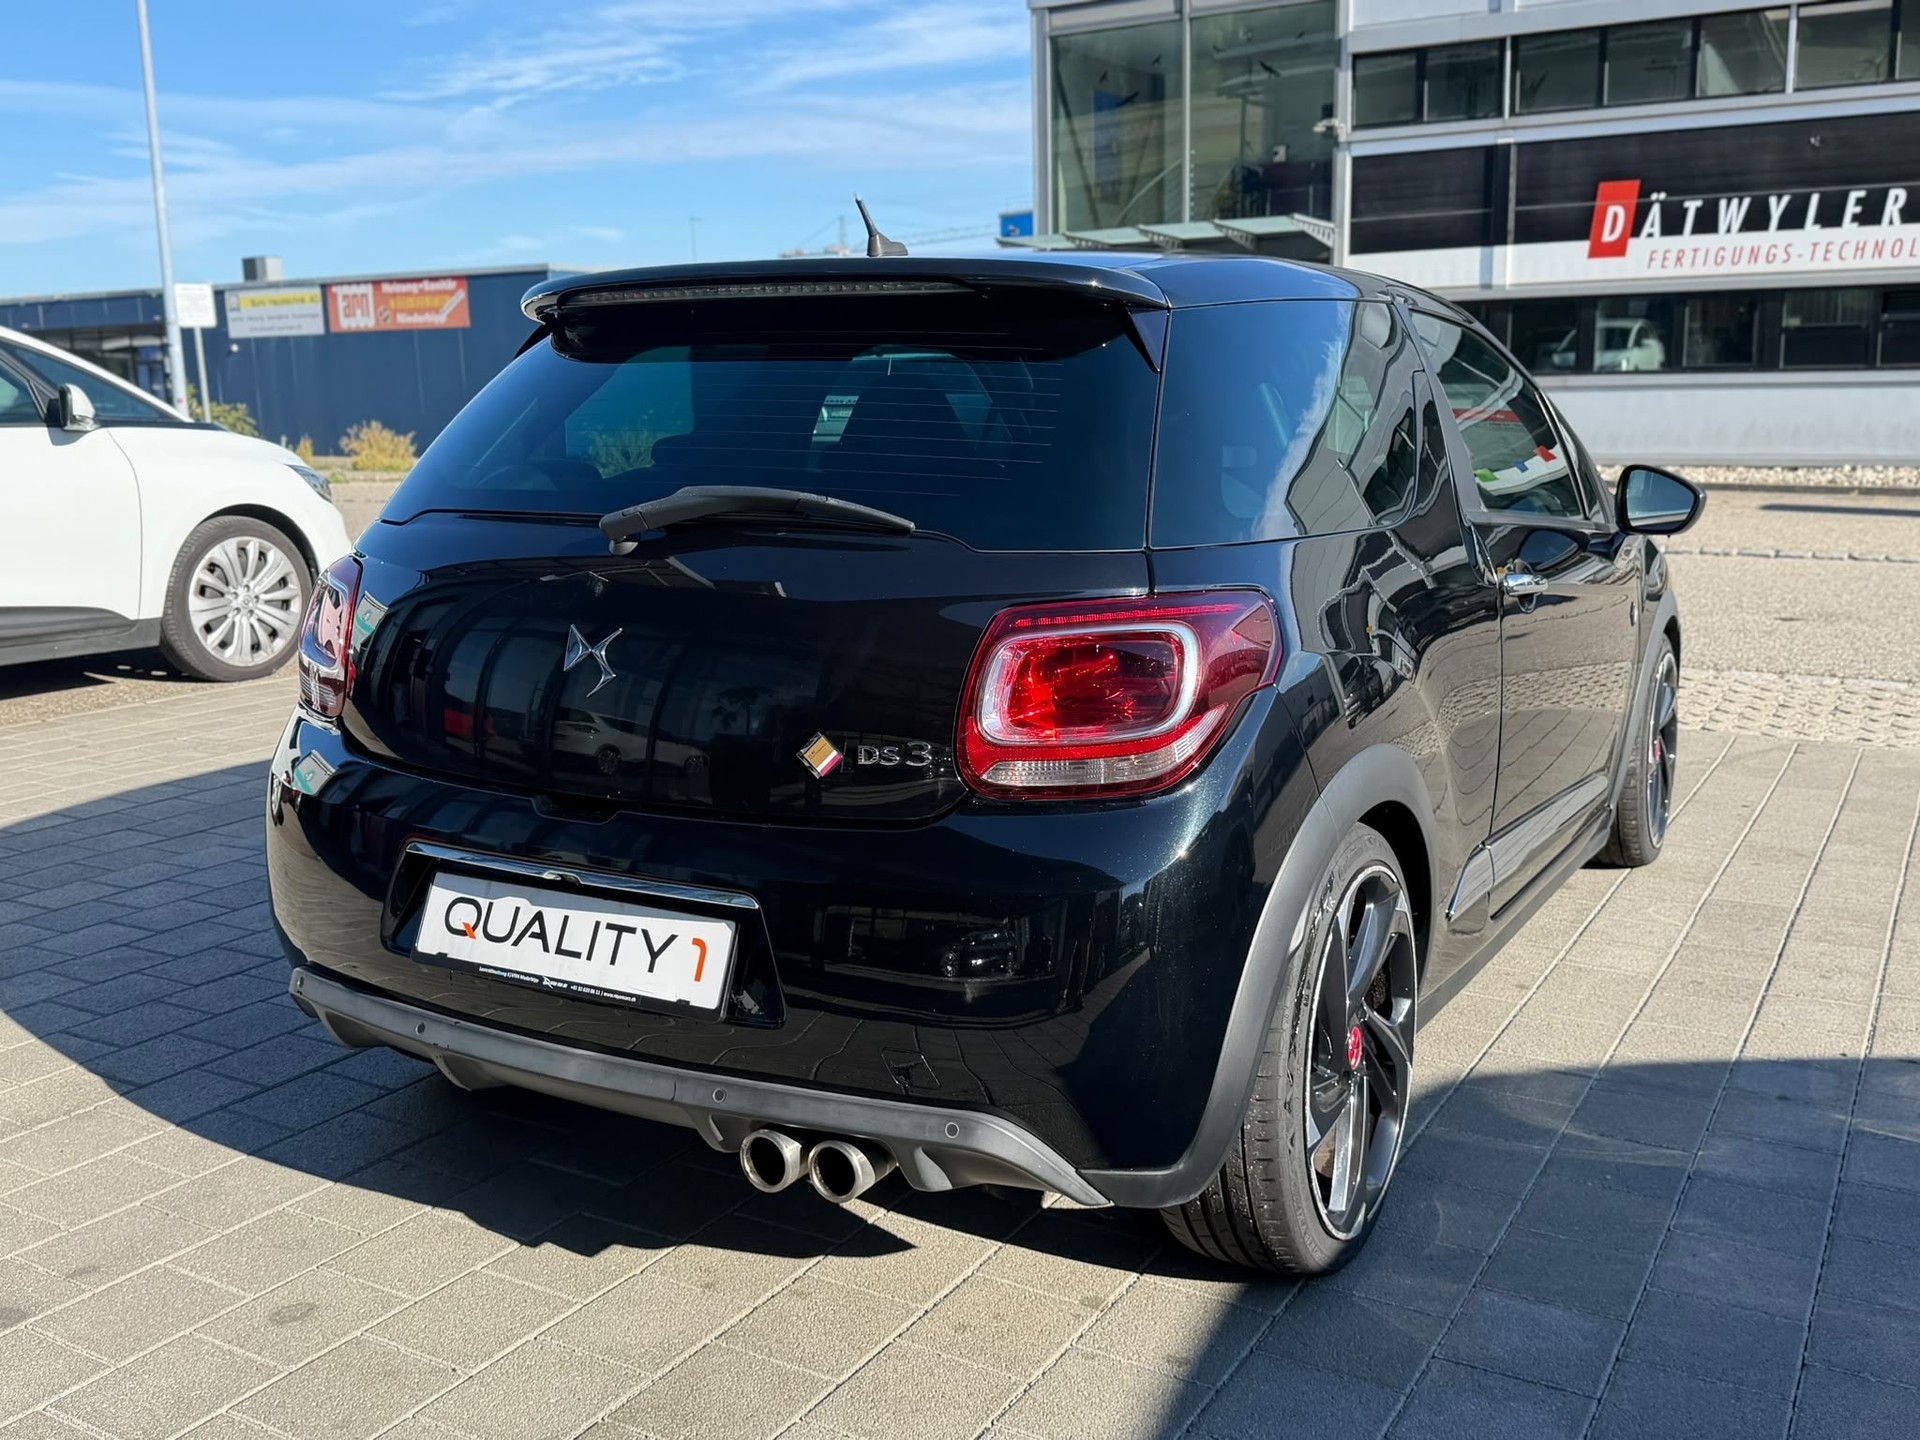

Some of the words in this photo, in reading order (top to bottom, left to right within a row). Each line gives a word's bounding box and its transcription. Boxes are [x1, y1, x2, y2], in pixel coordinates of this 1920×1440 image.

[1601, 187, 1908, 243] DÄTWYLER
[1646, 237, 1918, 270] FERTIGUNGS-TECHNOL
[857, 745, 900, 766] DS
[905, 740, 933, 767] 3
[444, 896, 679, 974] QUALITY
[691, 936, 707, 983] 1
